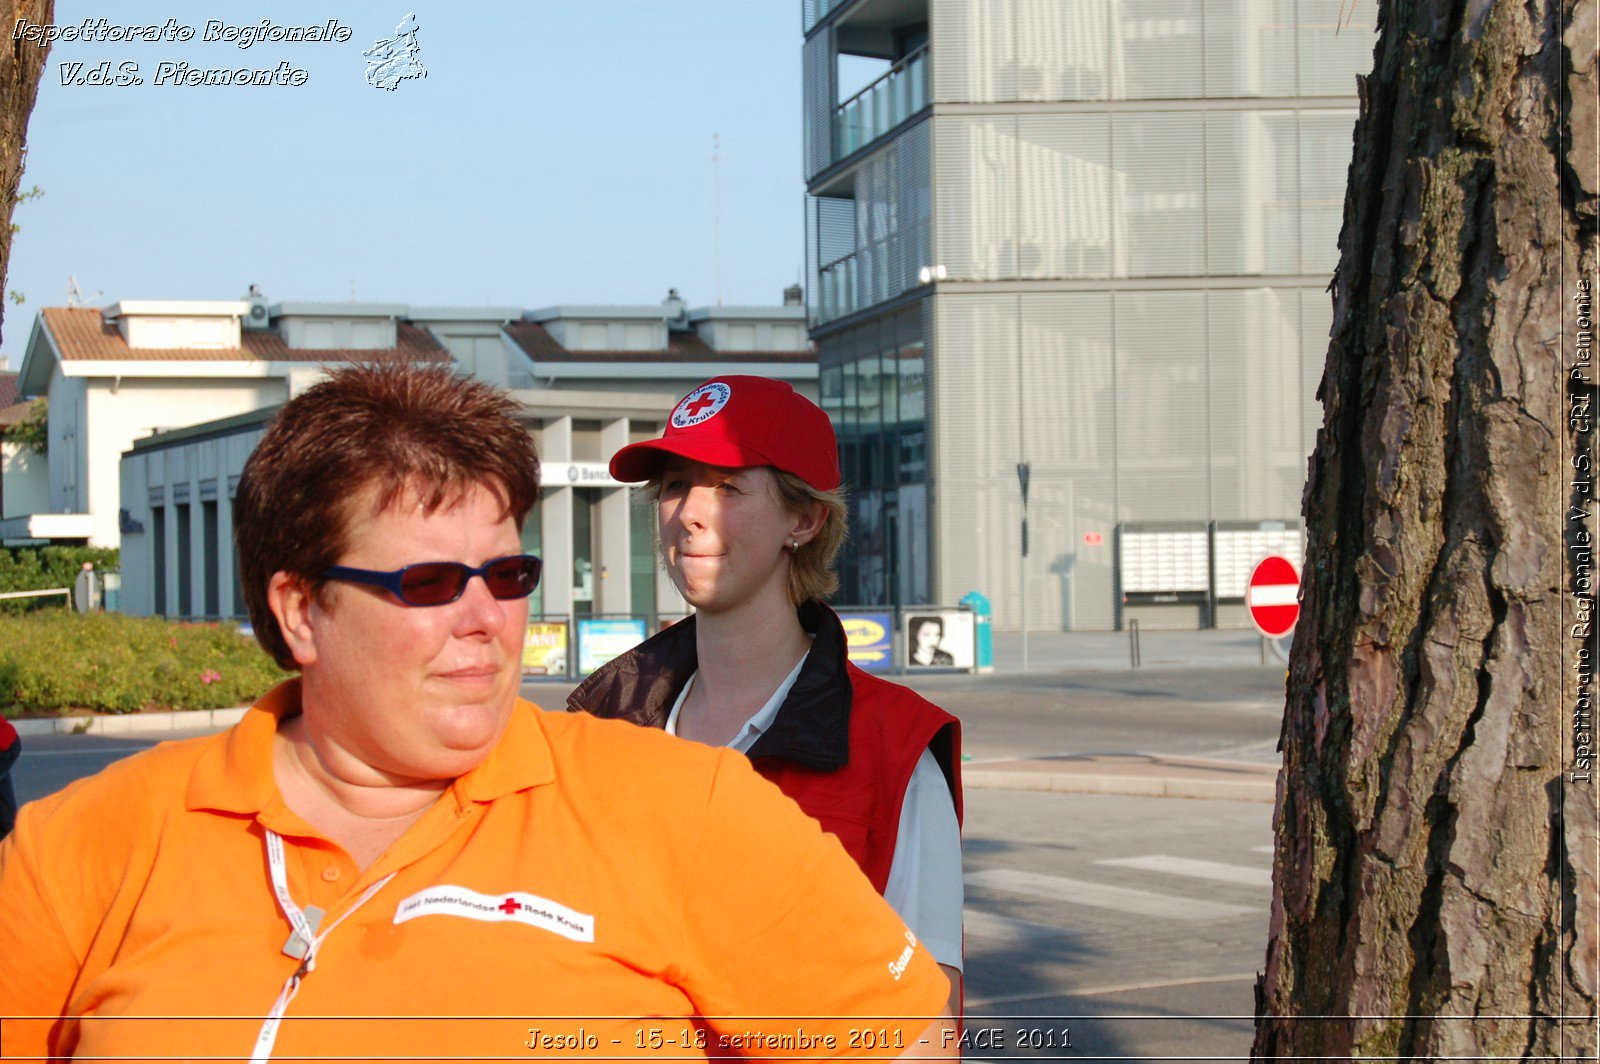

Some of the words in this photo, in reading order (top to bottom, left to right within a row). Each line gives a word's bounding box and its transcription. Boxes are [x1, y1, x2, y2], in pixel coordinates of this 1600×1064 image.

[687, 409, 715, 425] Kruis
[424, 896, 495, 912] Nederlandse
[524, 904, 554, 921] Rode
[556, 915, 585, 933] Kruis
[888, 944, 914, 981] Team
